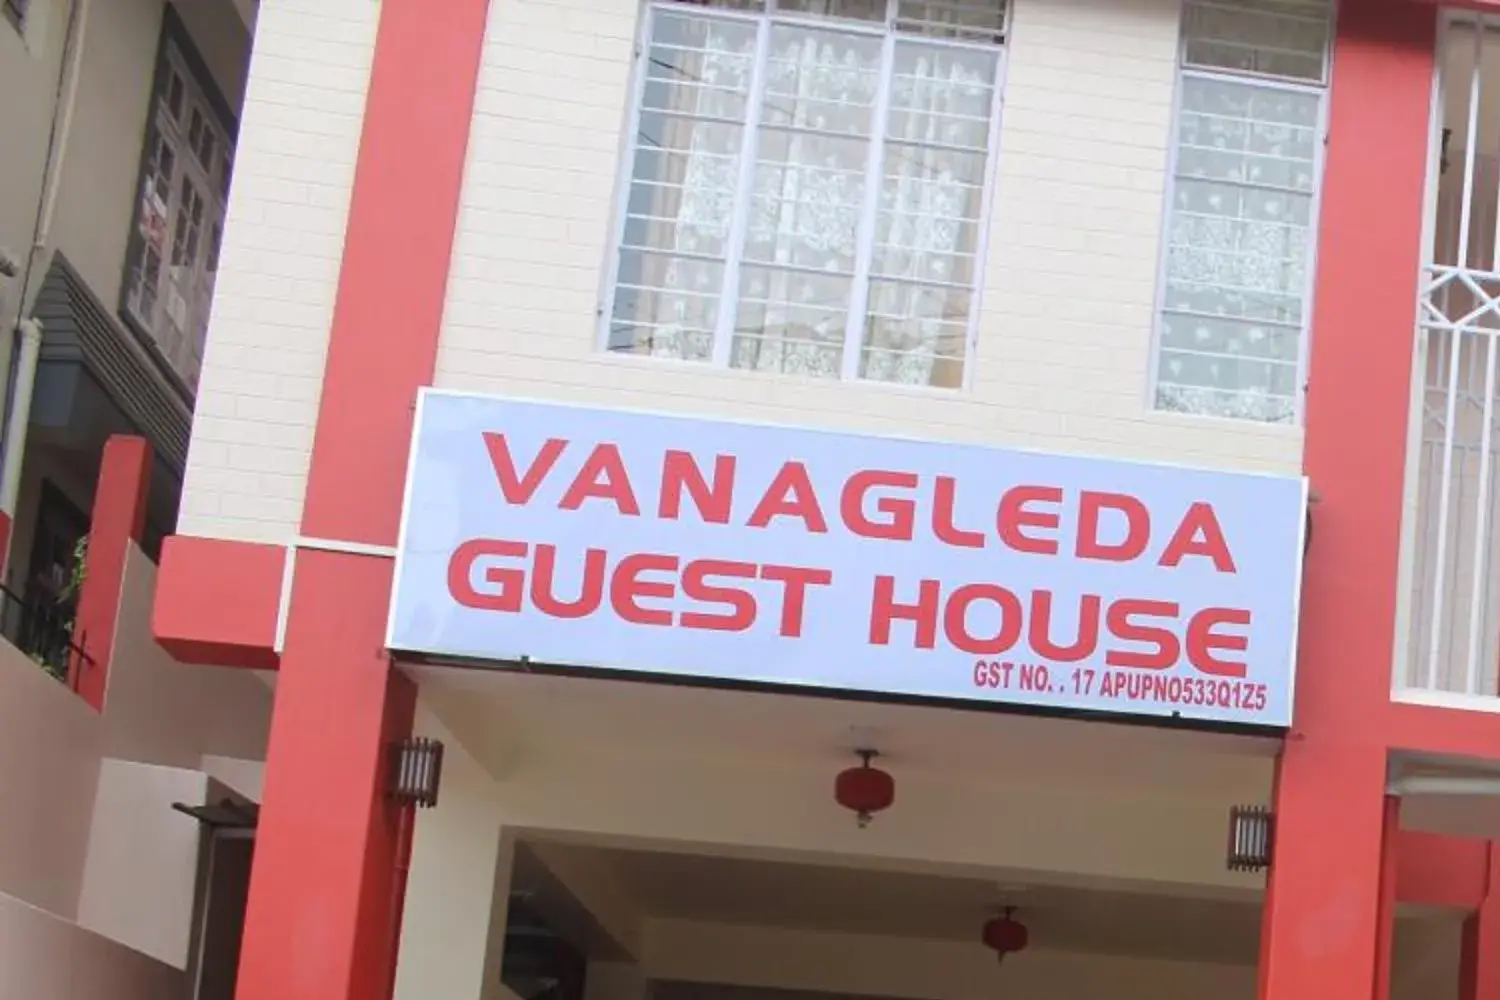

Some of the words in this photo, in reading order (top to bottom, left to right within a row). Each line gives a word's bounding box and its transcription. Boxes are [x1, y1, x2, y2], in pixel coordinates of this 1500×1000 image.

[482, 431, 1237, 574] VANAGLEDA
[447, 538, 833, 638] GUEST
[868, 574, 1251, 678] HOUSE
[973, 660, 1014, 689] GST
[1072, 669, 1096, 695] 17
